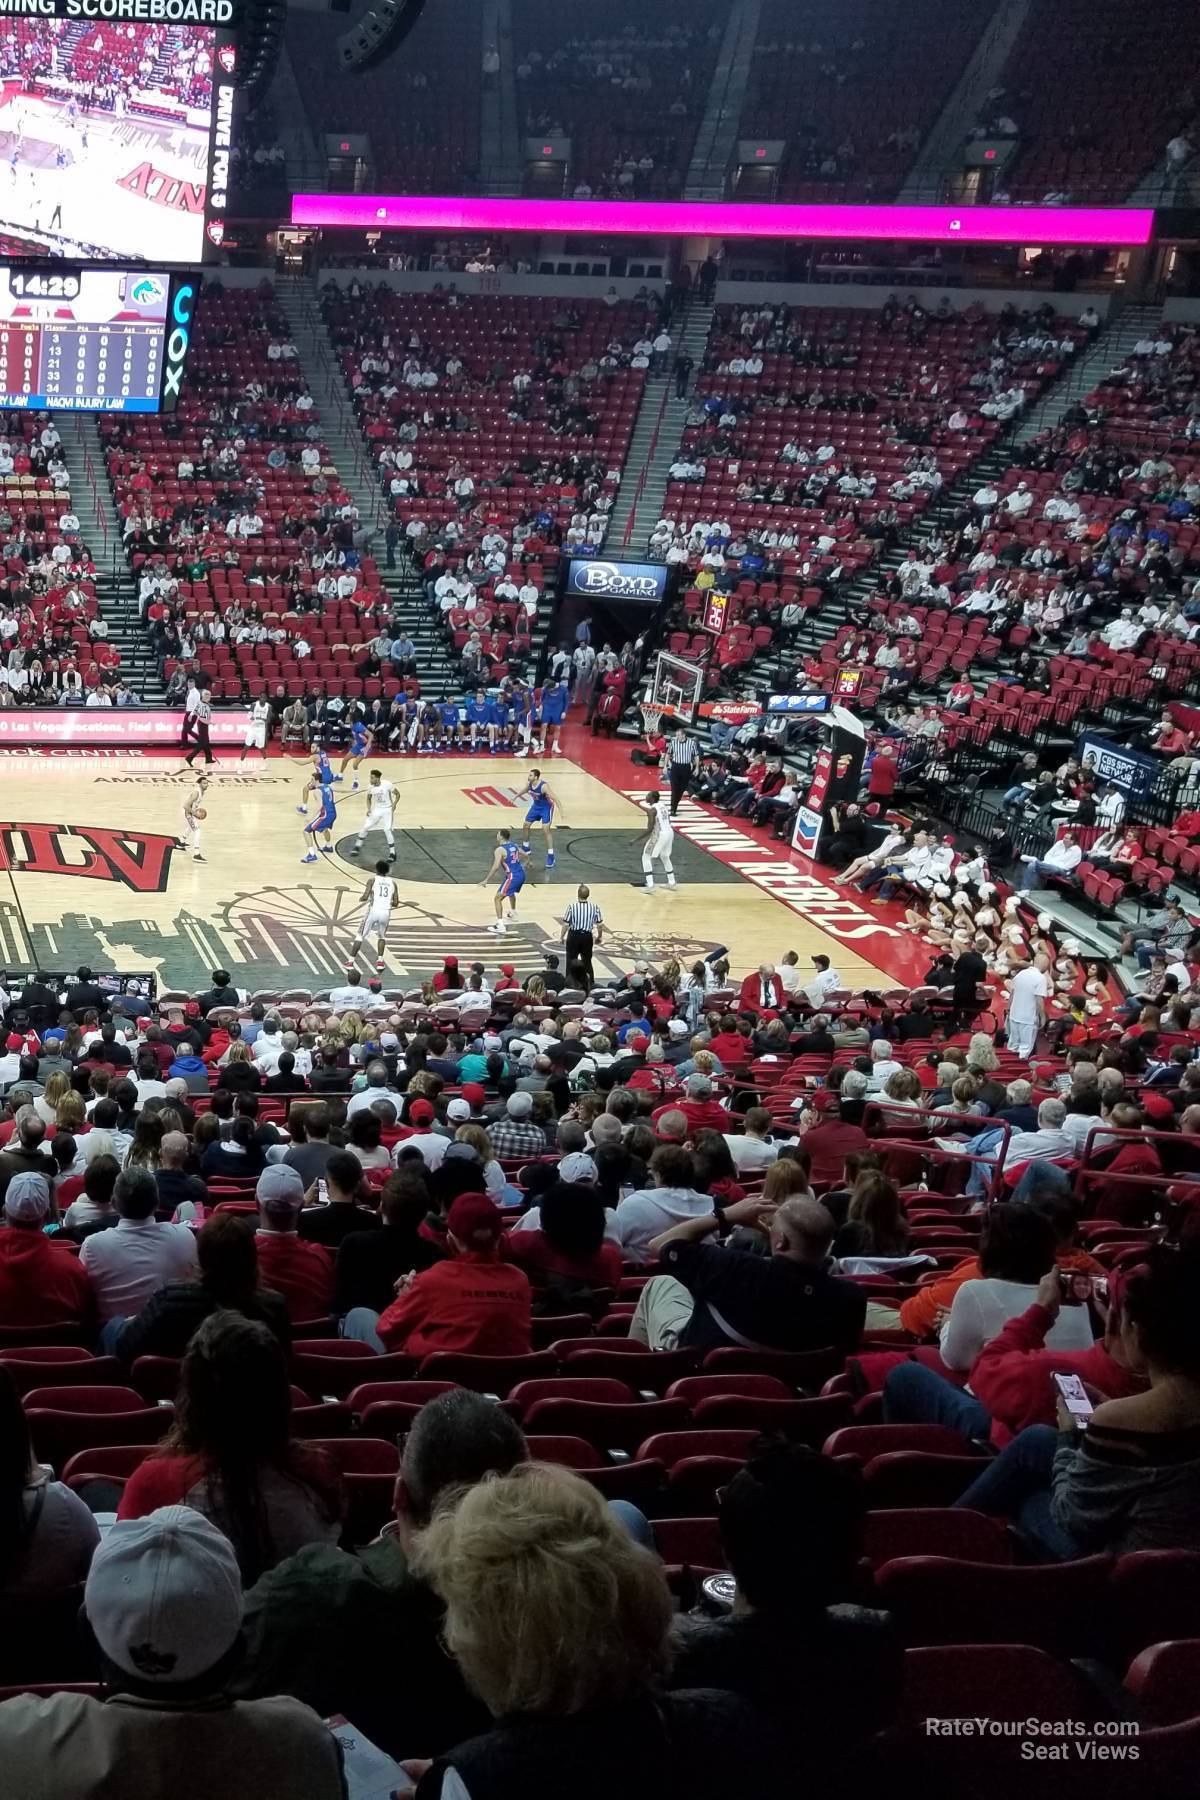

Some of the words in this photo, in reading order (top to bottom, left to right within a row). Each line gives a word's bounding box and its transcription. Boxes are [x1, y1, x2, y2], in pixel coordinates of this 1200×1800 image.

[67, 0, 233, 21] SCOREBOARD
[215, 85, 235, 147] DRIVE
[213, 150, 230, 190] FOR
[11, 274, 79, 298] 14:29
[0, 332, 9, 343] 0
[25, 333, 34, 343] 0
[52, 334, 59, 343] 3
[78, 335, 87, 345] 0
[100, 336, 109, 346] 0
[126, 337, 132, 347] 1
[150, 337, 158, 347] 0
[164, 286, 192, 396] COX
[1, 346, 8, 355] 1
[24, 346, 33, 356] 0
[48, 347, 62, 356] 13
[77, 348, 86, 358] 0
[99, 348, 108, 358] 0
[124, 349, 132, 359] 0
[148, 350, 157, 360] 0
[0, 358, 8, 368] 0
[24, 359, 32, 369] 0
[47, 359, 60, 368] 21
[77, 360, 85, 370] 0
[98, 360, 107, 370] 0
[123, 361, 132, 371] 0
[148, 362, 156, 372] 0
[0, 370, 7, 380] 0
[24, 371, 30, 380] 1
[47, 371, 60, 380] 33
[76, 372, 85, 382] 0
[97, 373, 106, 383] 0
[122, 373, 130, 383] 0
[146, 374, 155, 384] 0
[23, 383, 31, 393] 0
[46, 384, 59, 393] 34
[75, 384, 84, 394] 0
[97, 385, 105, 395] 0
[121, 386, 129, 396] 0
[145, 386, 154, 396] 0
[9, 395, 29, 407] LAW
[46, 397, 73, 407] NAQVI
[75, 398, 105, 408] INJURY
[106, 398, 126, 409] LAW
[586, 568, 658, 590] BOYD
[609, 586, 658, 597] GAMING
[709, 606, 722, 628] 26
[839, 681, 854, 692] 26
[11, 721, 30, 732] Las
[72, 720, 125, 734] ocations,
[128, 721, 151, 732] Find
[154, 721, 173, 732] the
[50, 748, 146, 758] CENTER
[1101, 754, 1118, 768] CBS
[378, 885, 389, 898] 13
[729, 861, 902, 939] REBELS
[623, 944, 706, 952] VEGAS
